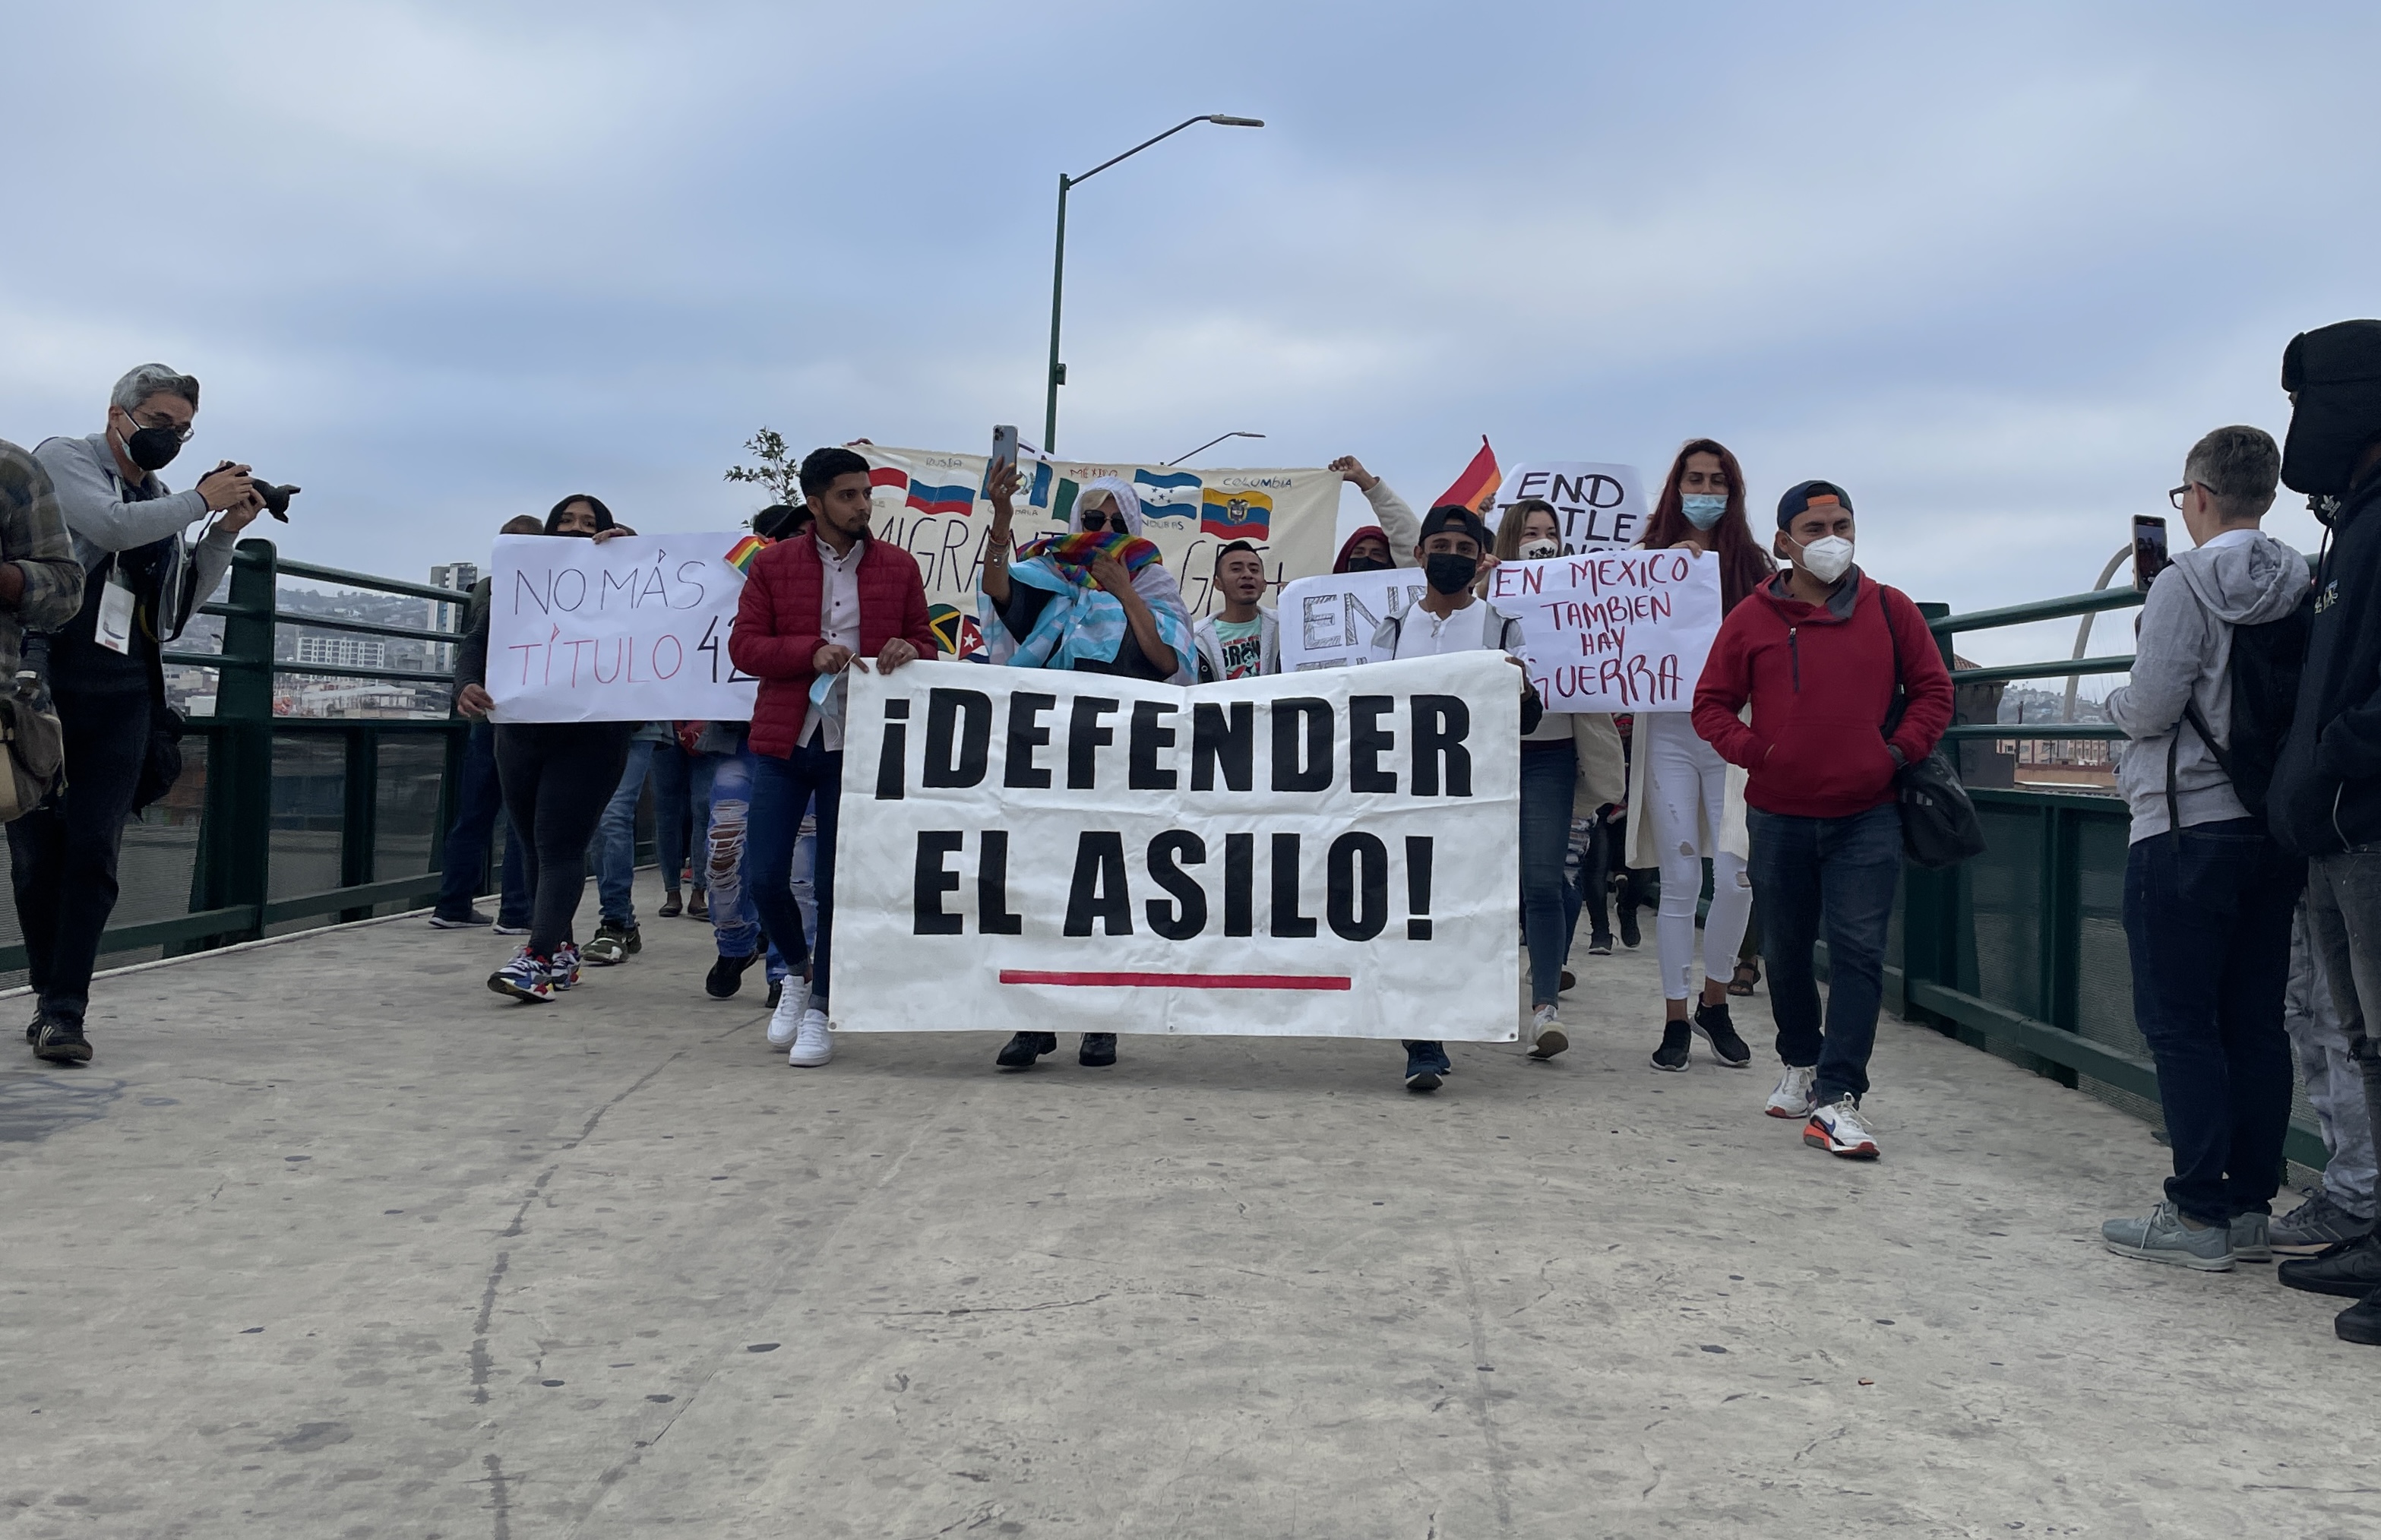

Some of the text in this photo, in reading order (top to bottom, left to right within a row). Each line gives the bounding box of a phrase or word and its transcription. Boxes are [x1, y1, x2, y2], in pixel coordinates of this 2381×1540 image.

[1516, 472, 1624, 508] END
[1497, 503, 1637, 542] TLE
[514, 549, 707, 615] NO MÁS
[1492, 564, 1545, 599] EN
[508, 623, 683, 688] TÍTULO
[1580, 626, 1626, 663] HAY
[874, 688, 1473, 800] ¡DEFENDER
[913, 829, 1434, 941] EL ASILO!
